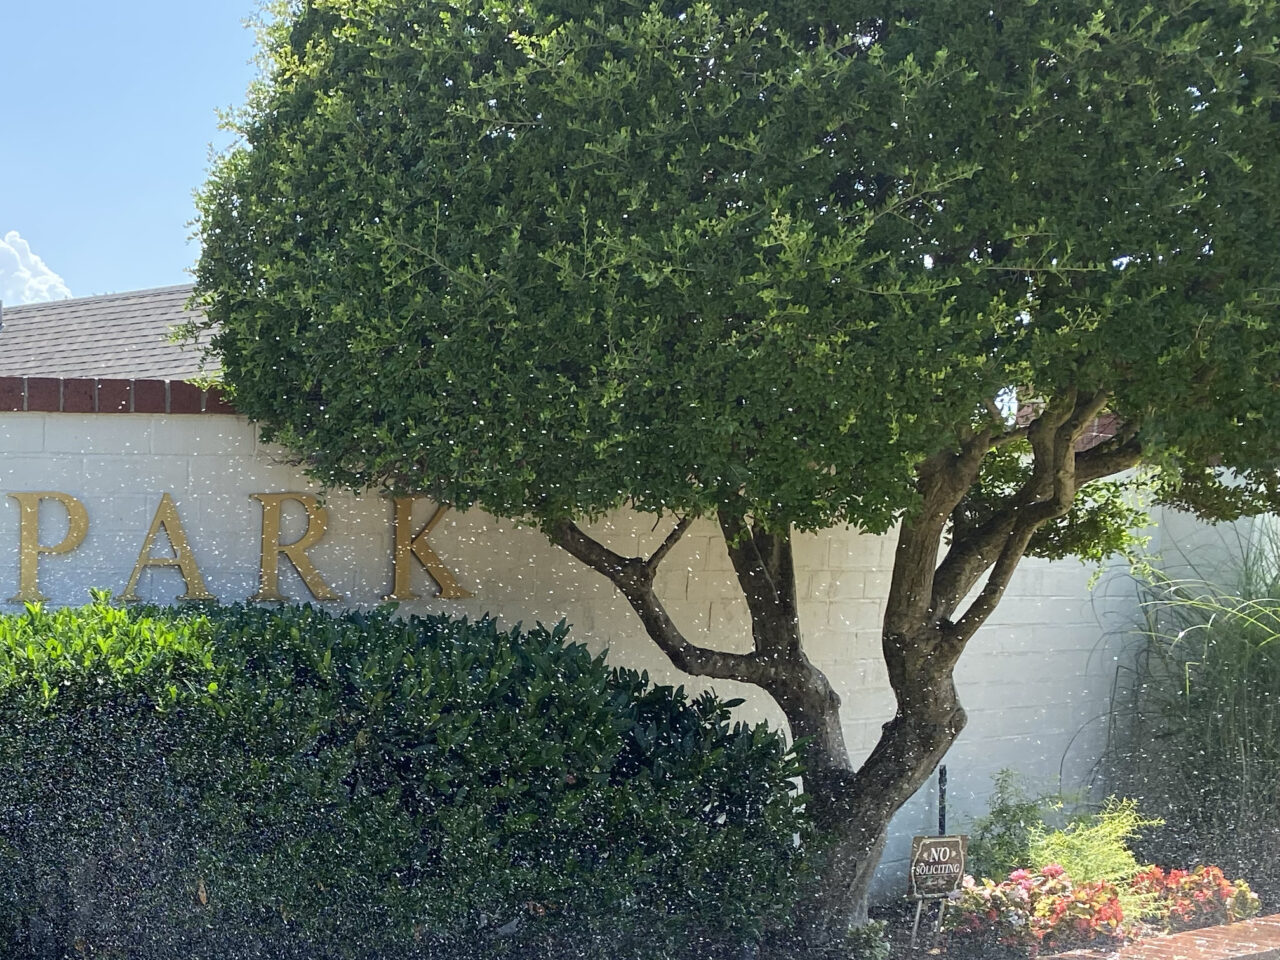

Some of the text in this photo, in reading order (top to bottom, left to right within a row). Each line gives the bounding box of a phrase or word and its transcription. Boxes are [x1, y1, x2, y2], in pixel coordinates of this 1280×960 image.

[7, 492, 475, 602] PARK
[930, 847, 950, 862] NO
[915, 864, 960, 875] SOLICITING
